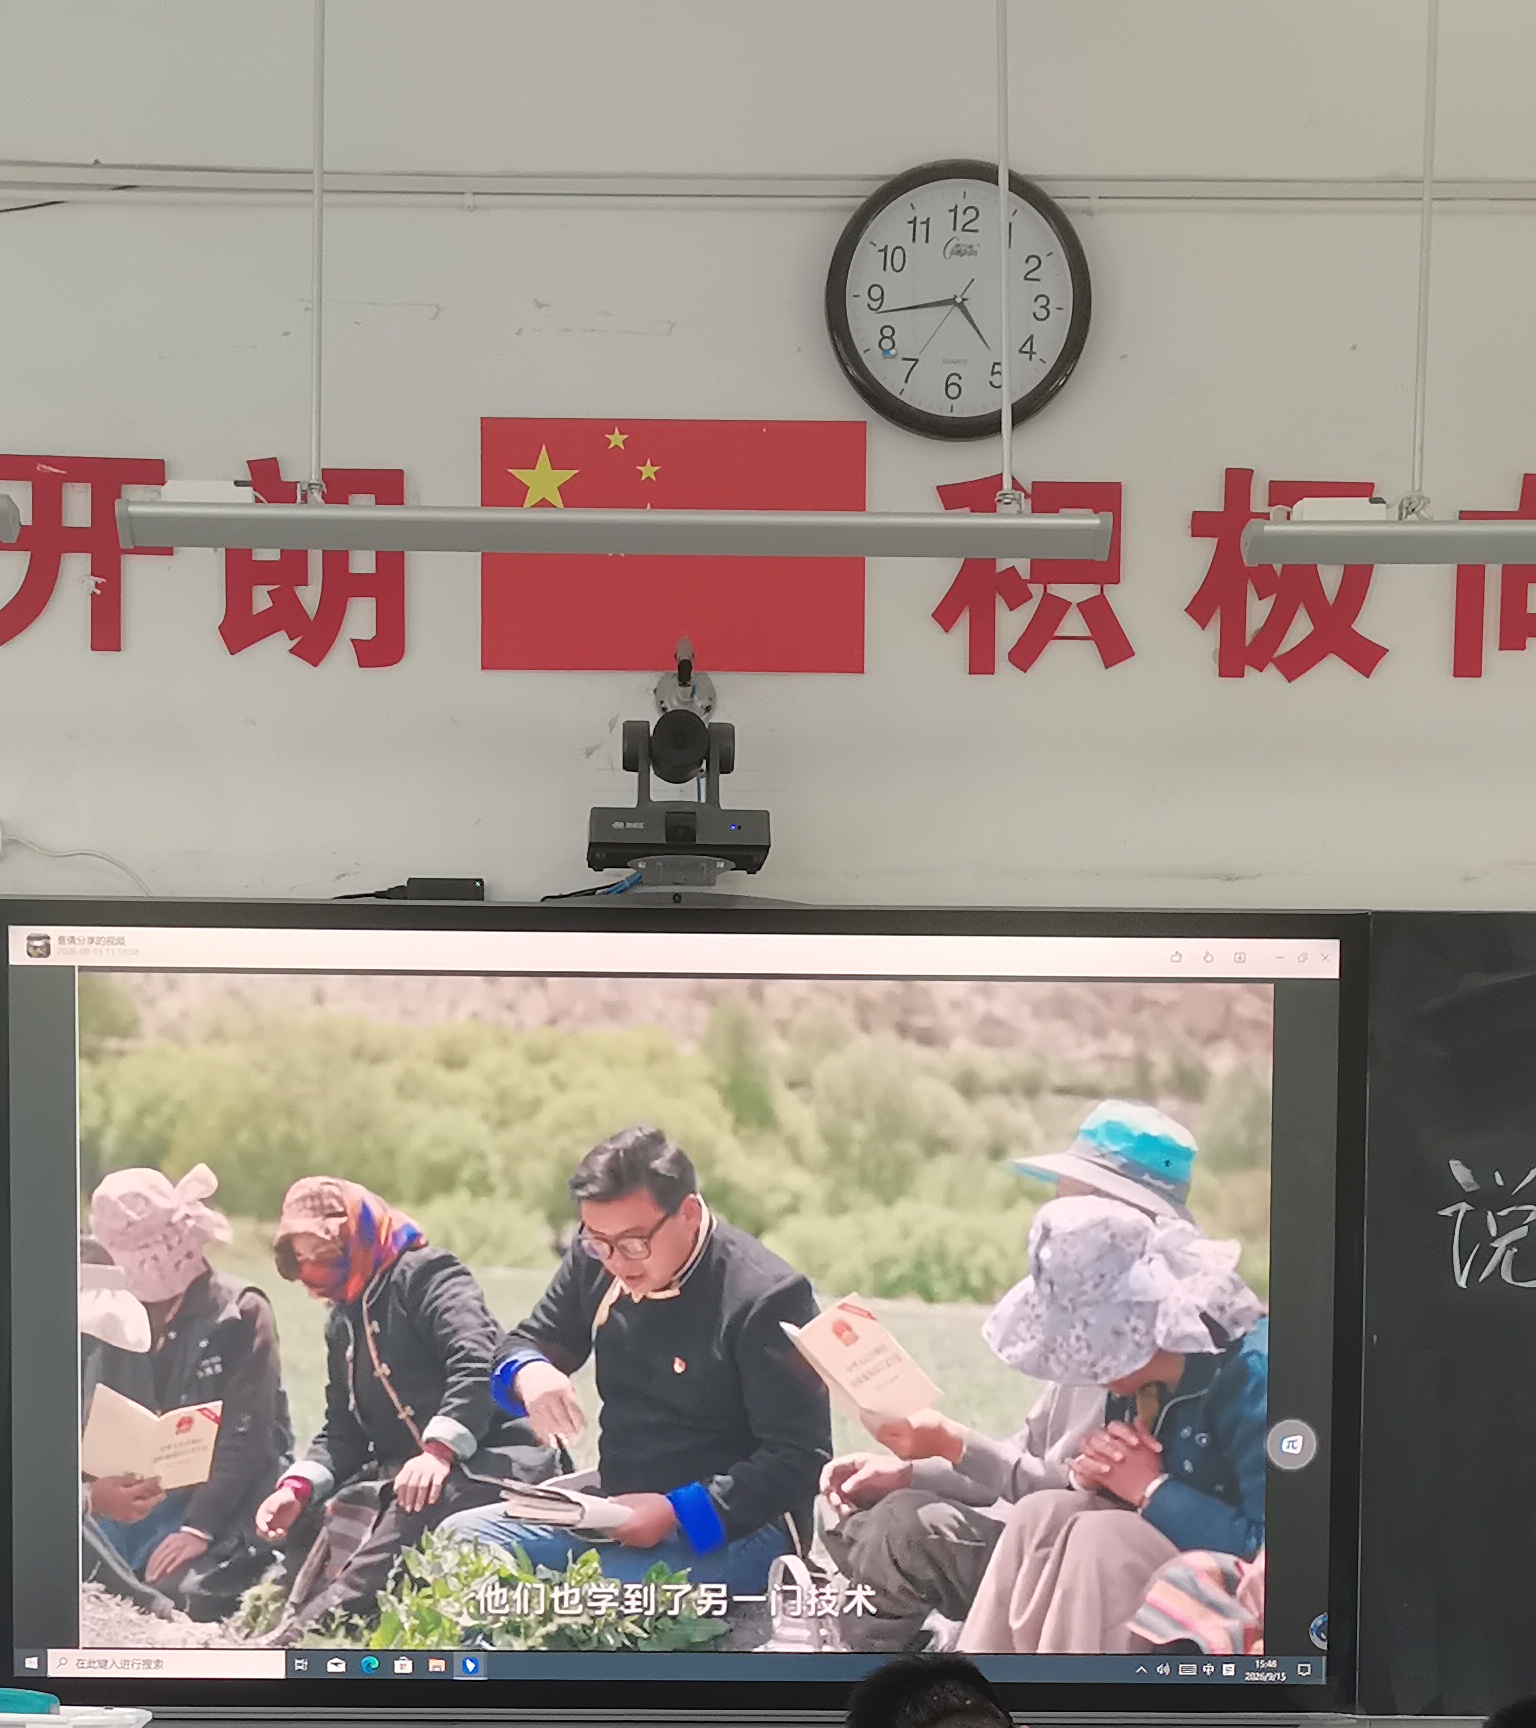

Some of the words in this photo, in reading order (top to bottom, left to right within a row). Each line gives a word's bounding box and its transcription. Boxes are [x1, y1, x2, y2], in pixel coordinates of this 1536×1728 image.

[907, 216, 931, 244] 11
[948, 204, 980, 233] 12
[878, 245, 906, 273] 10
[1023, 254, 1042, 282] 2
[867, 284, 885, 312] 9
[1032, 294, 1051, 321] 3
[878, 325, 896, 351] 8
[1018, 334, 1037, 361] 4
[901, 357, 920, 384] 7
[989, 361, 1003, 389] 5
[944, 372, 962, 400] 6
[475, 1583, 878, 1617] 他们也学到了另一门技术
